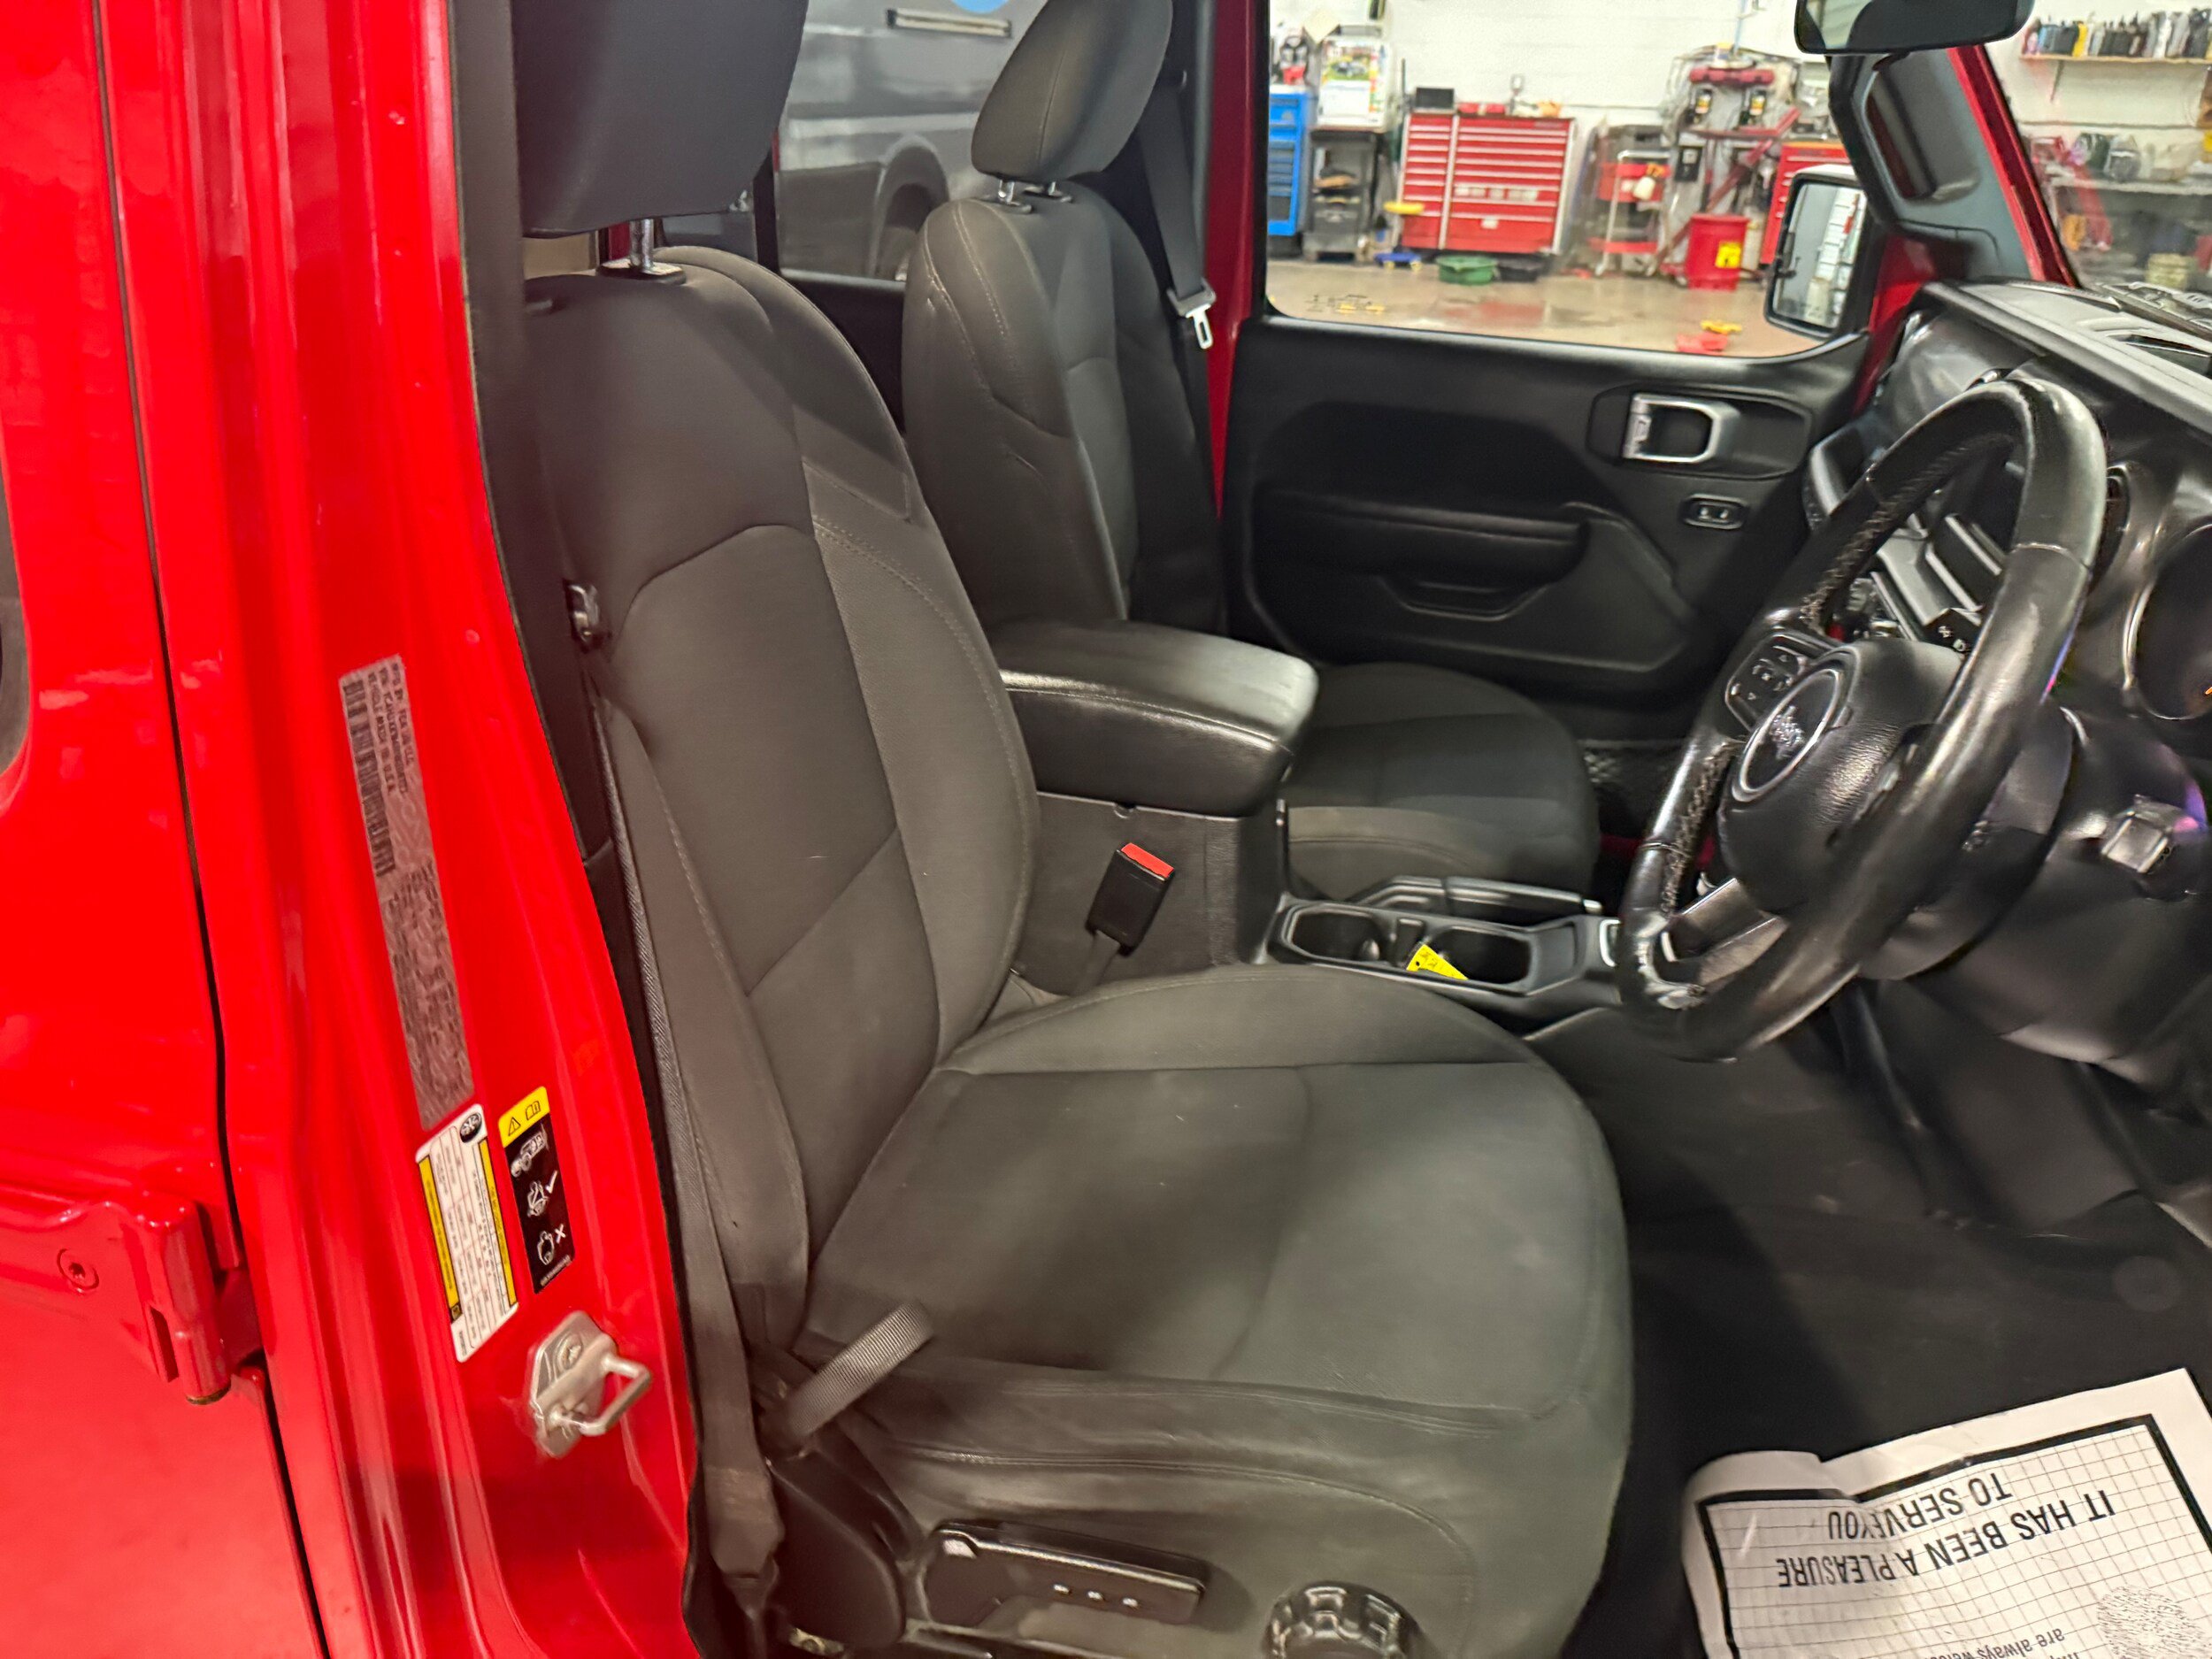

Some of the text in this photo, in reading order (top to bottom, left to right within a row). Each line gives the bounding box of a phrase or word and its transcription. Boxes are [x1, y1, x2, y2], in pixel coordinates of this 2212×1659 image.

[1968, 1472, 2014, 1507] TO
[1776, 1490, 2116, 1586] IT HAS BEEN A PLEASURE
[1978, 1628, 2065, 1659] are always
